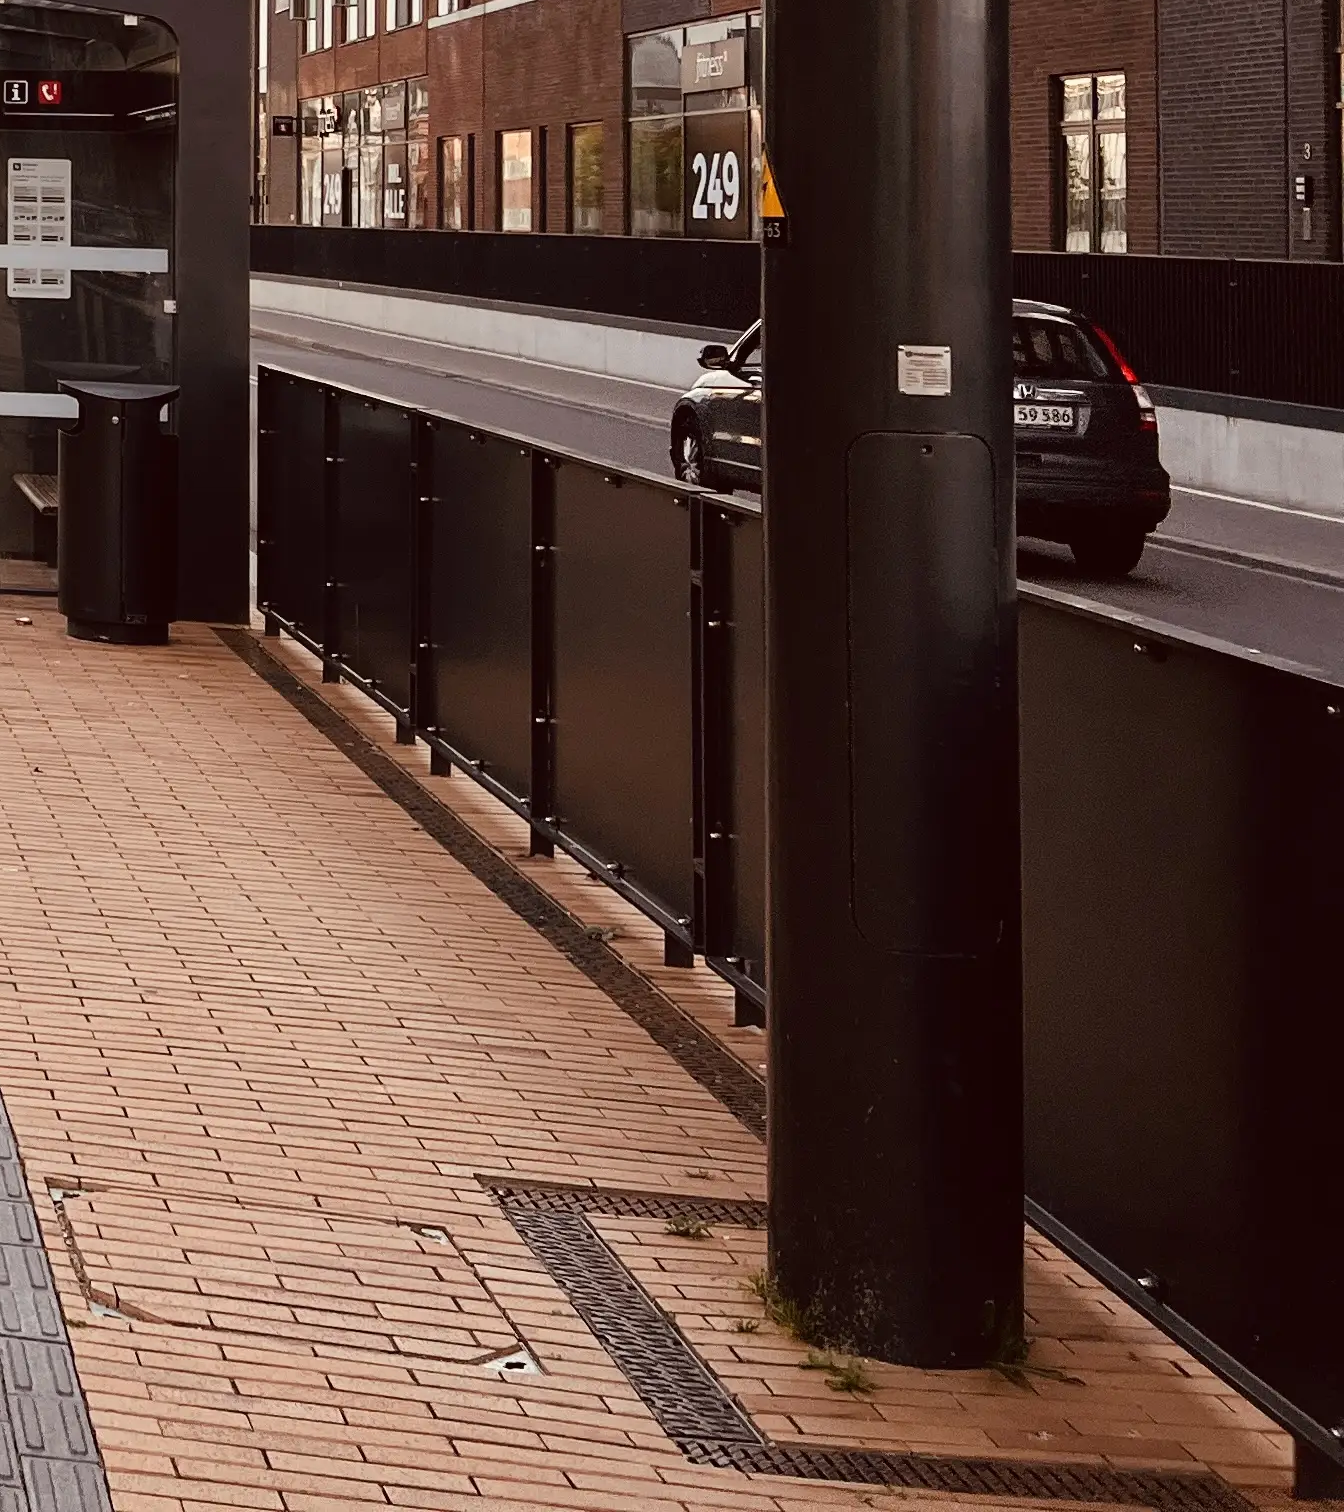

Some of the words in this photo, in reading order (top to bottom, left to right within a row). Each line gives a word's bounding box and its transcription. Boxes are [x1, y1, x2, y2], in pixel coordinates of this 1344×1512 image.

[1303, 142, 1311, 160] 3
[691, 151, 740, 220] 249
[1018, 407, 1038, 422] 59
